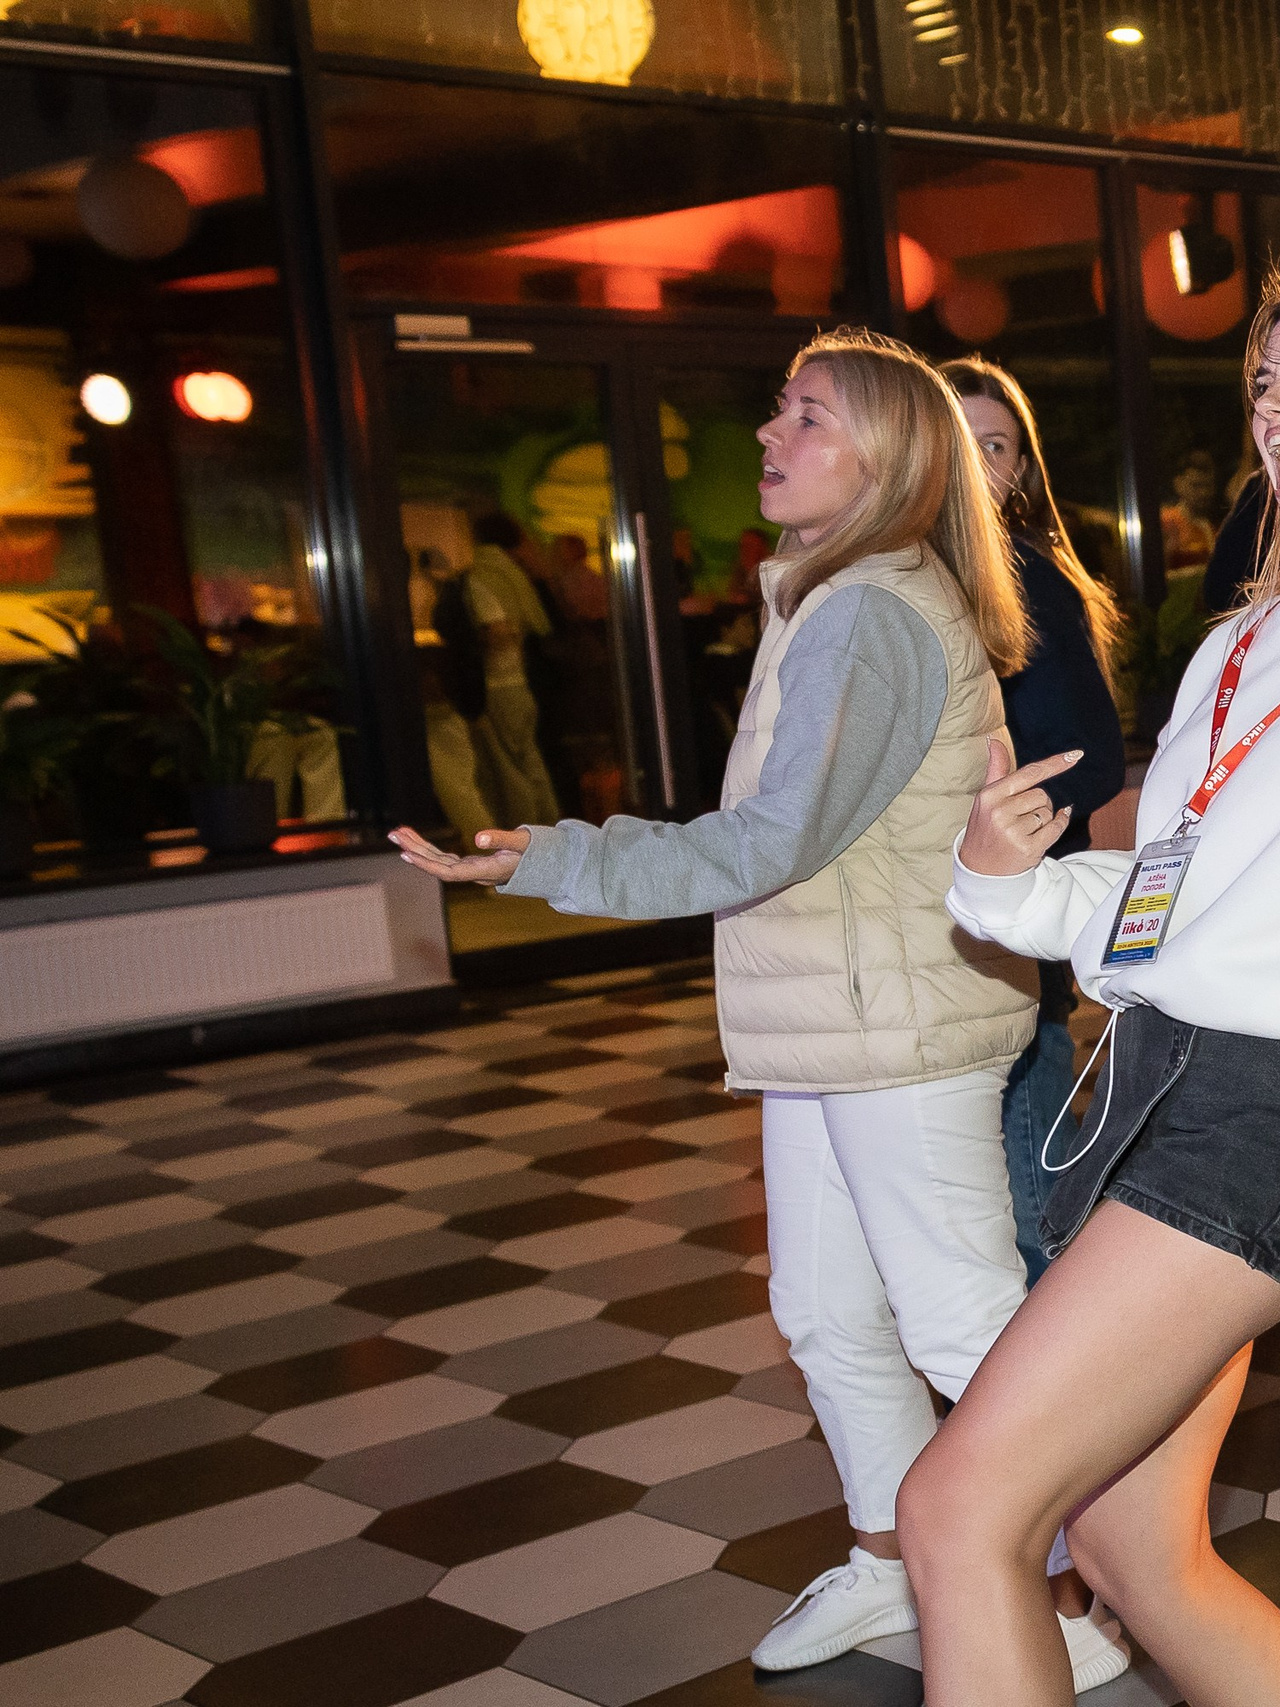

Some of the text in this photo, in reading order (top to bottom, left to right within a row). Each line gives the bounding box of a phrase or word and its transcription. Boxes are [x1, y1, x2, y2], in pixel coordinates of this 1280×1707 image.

[1141, 861, 1182, 873] MULTI PASS
[1146, 918, 1160, 932] 20
